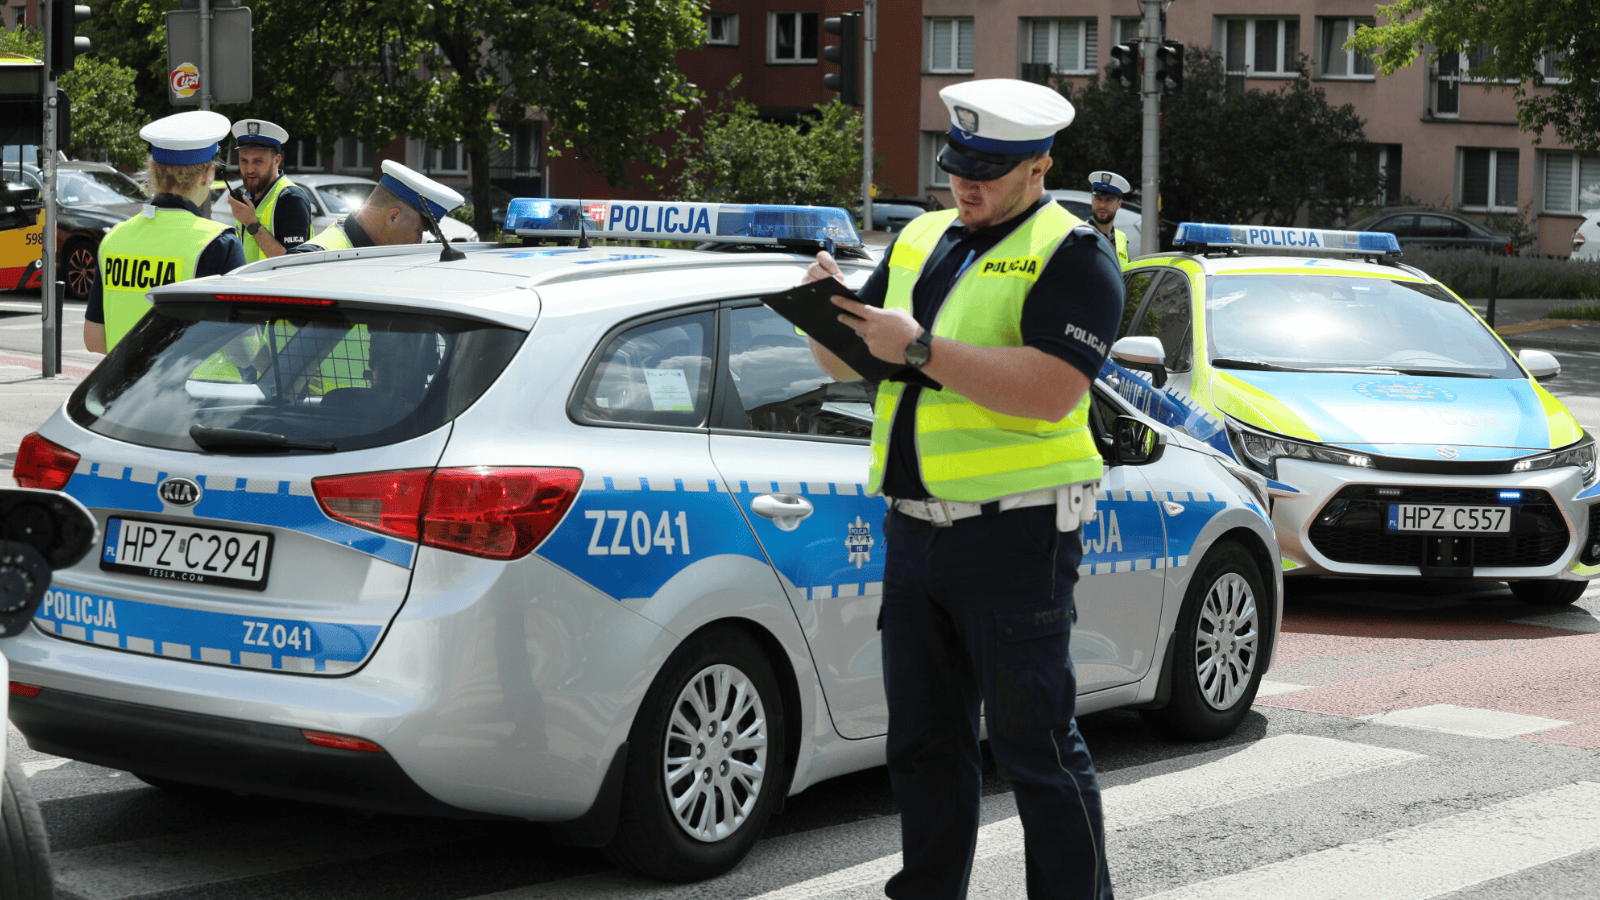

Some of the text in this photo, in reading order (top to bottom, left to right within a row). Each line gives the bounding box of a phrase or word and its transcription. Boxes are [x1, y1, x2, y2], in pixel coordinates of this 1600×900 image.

[609, 205, 711, 234] POLICJA
[1249, 229, 1320, 247] POLICJA
[105, 258, 175, 288] POLICJA
[983, 260, 1037, 275] POLICJA
[1064, 323, 1107, 357] POLICJA
[164, 483, 192, 501] KIA
[1403, 507, 1506, 530] HPZ C557
[584, 510, 691, 555] ZZ041
[106, 546, 116, 557] PL
[122, 525, 261, 577] HPZ C294
[149, 568, 204, 582] TESLA.COM
[43, 590, 117, 629] POLICJA
